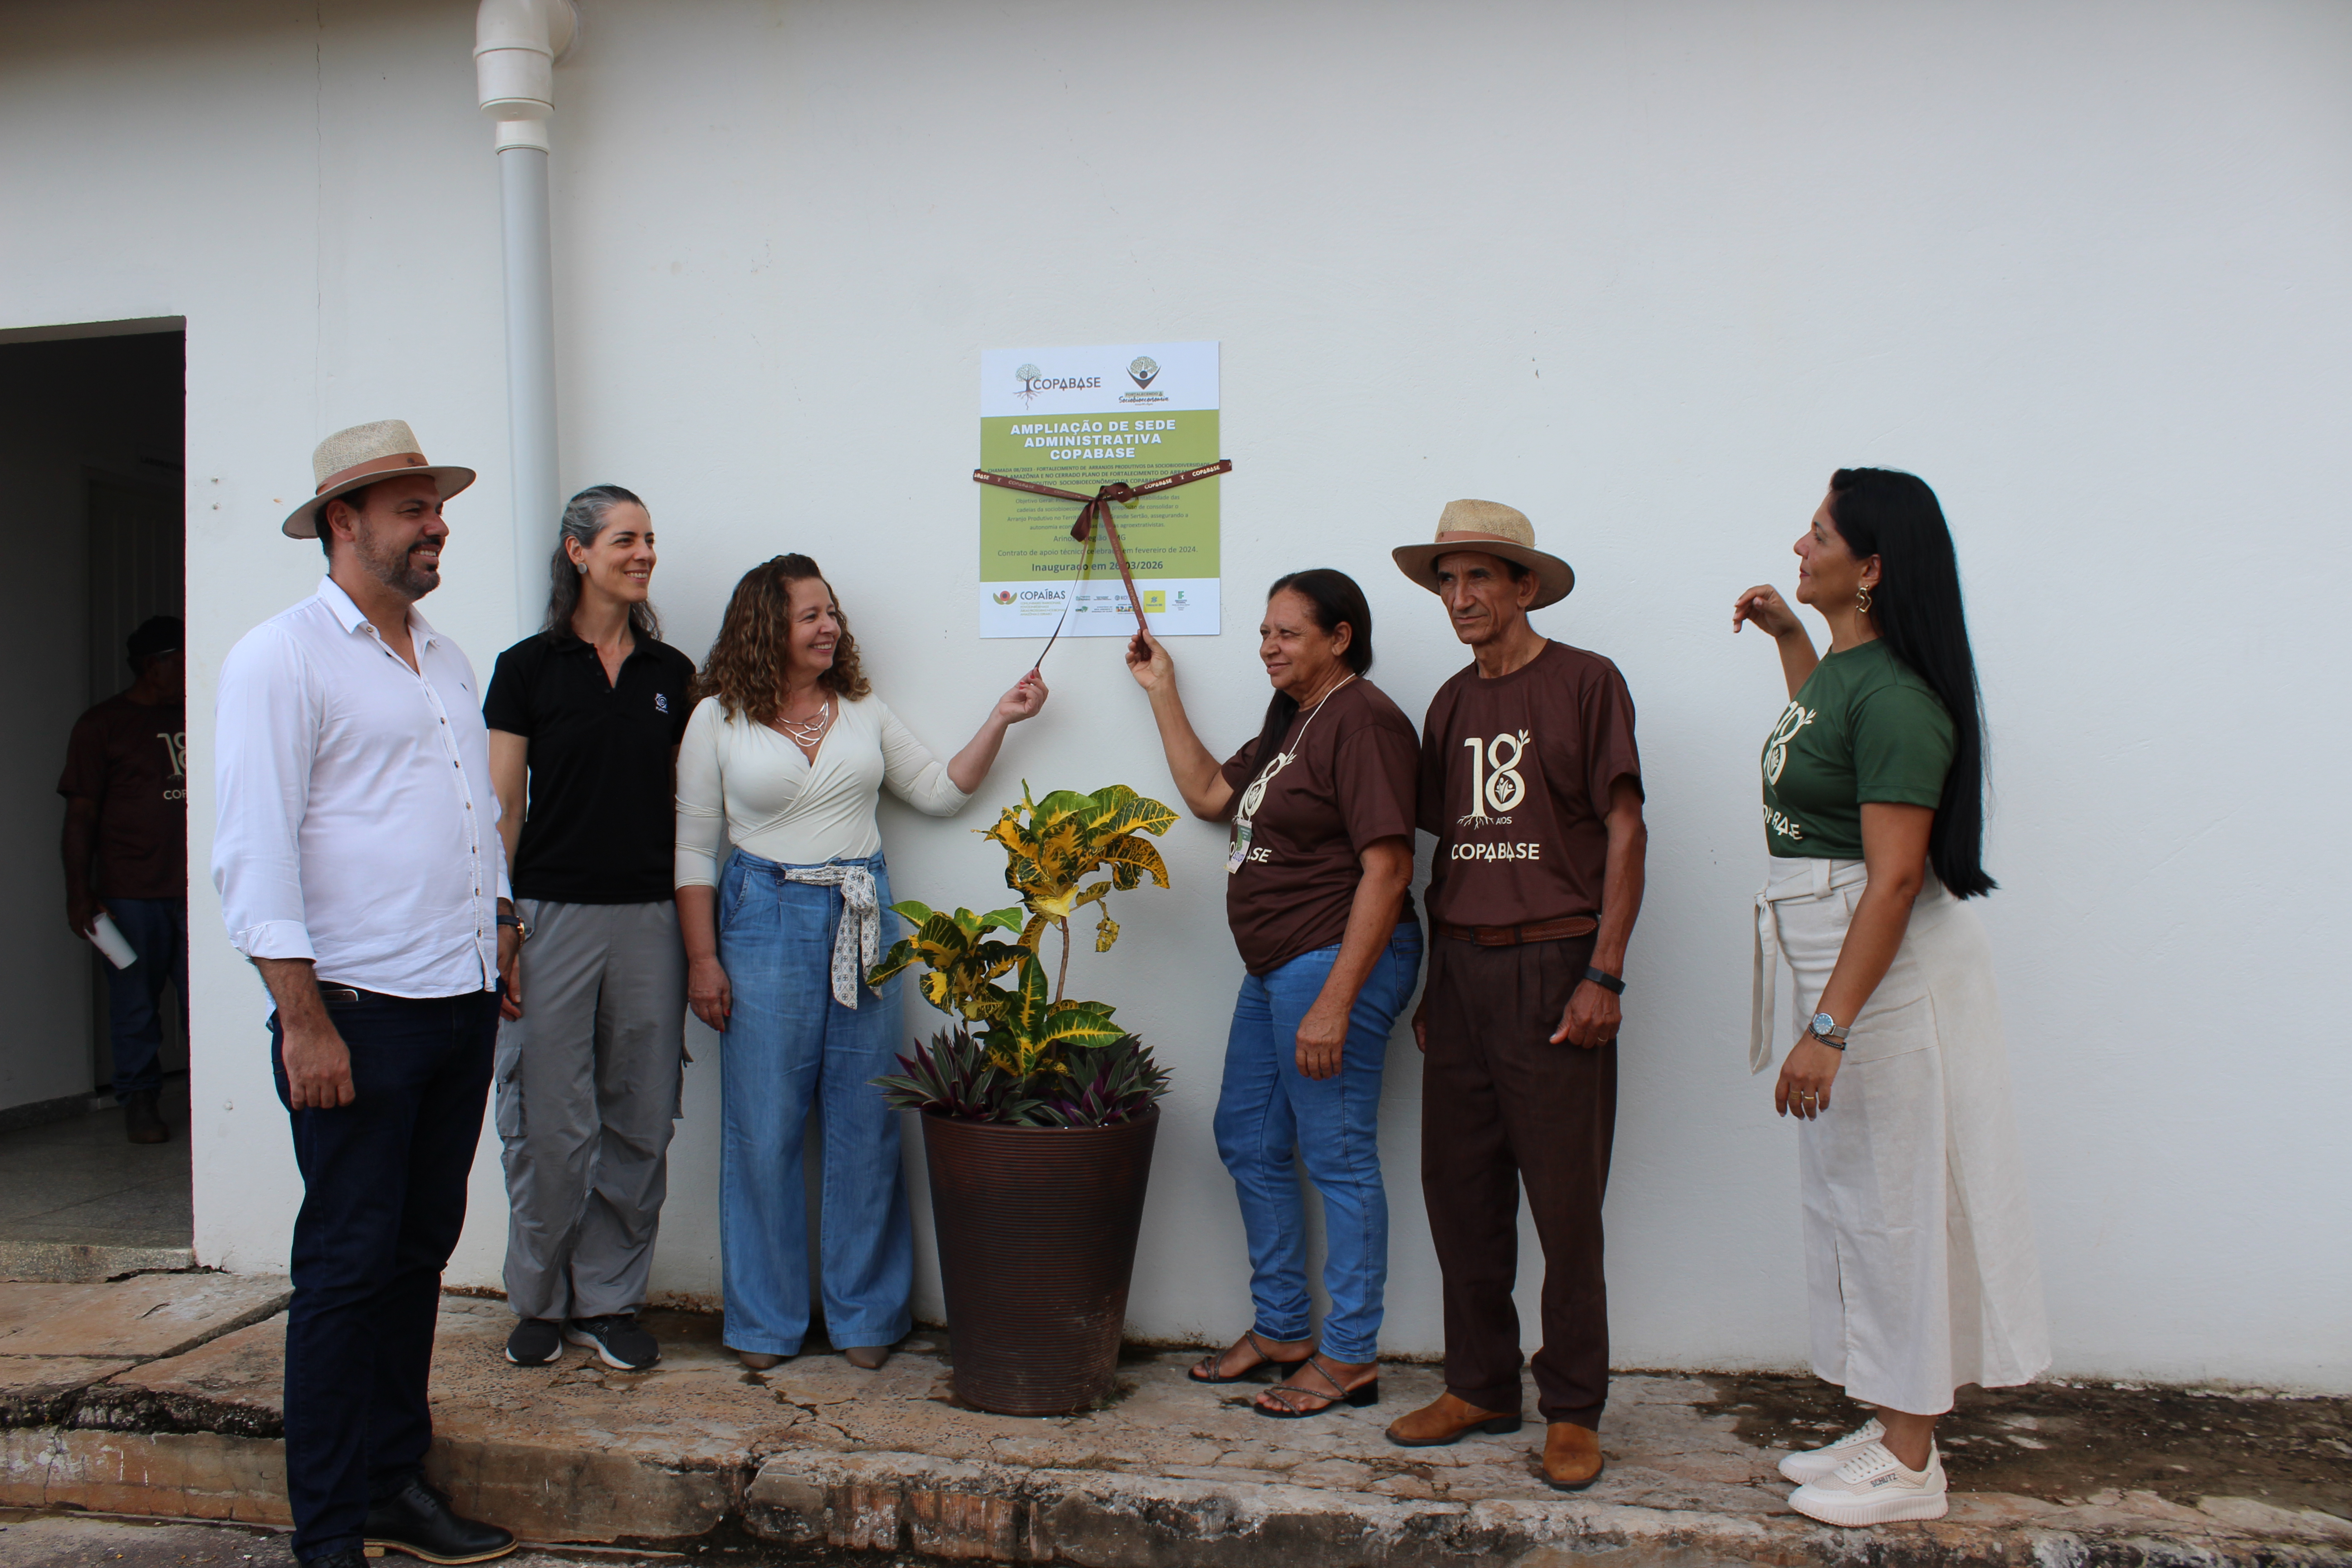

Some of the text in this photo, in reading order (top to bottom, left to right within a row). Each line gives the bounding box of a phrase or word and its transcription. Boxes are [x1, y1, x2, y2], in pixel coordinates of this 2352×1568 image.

[1033, 377, 1101, 391] COPABASE
[1010, 419, 1176, 435] AMPLIAÇÃO DE SEDE
[1024, 434, 1161, 448] ADMINISTRATIVA
[1050, 447, 1135, 460] COPABASE
[1192, 465, 1220, 477] COPABASE
[1144, 478, 1172, 490] COPABASE
[1032, 563, 1088, 573] Inaugurado
[1109, 561, 1163, 570] 2603/2026
[1020, 588, 1066, 600] COPAÍBAS
[1464, 732, 1525, 817] 18
[1451, 842, 1540, 862] COPABASE
[1870, 1473, 1898, 1487] SCHUTZ
